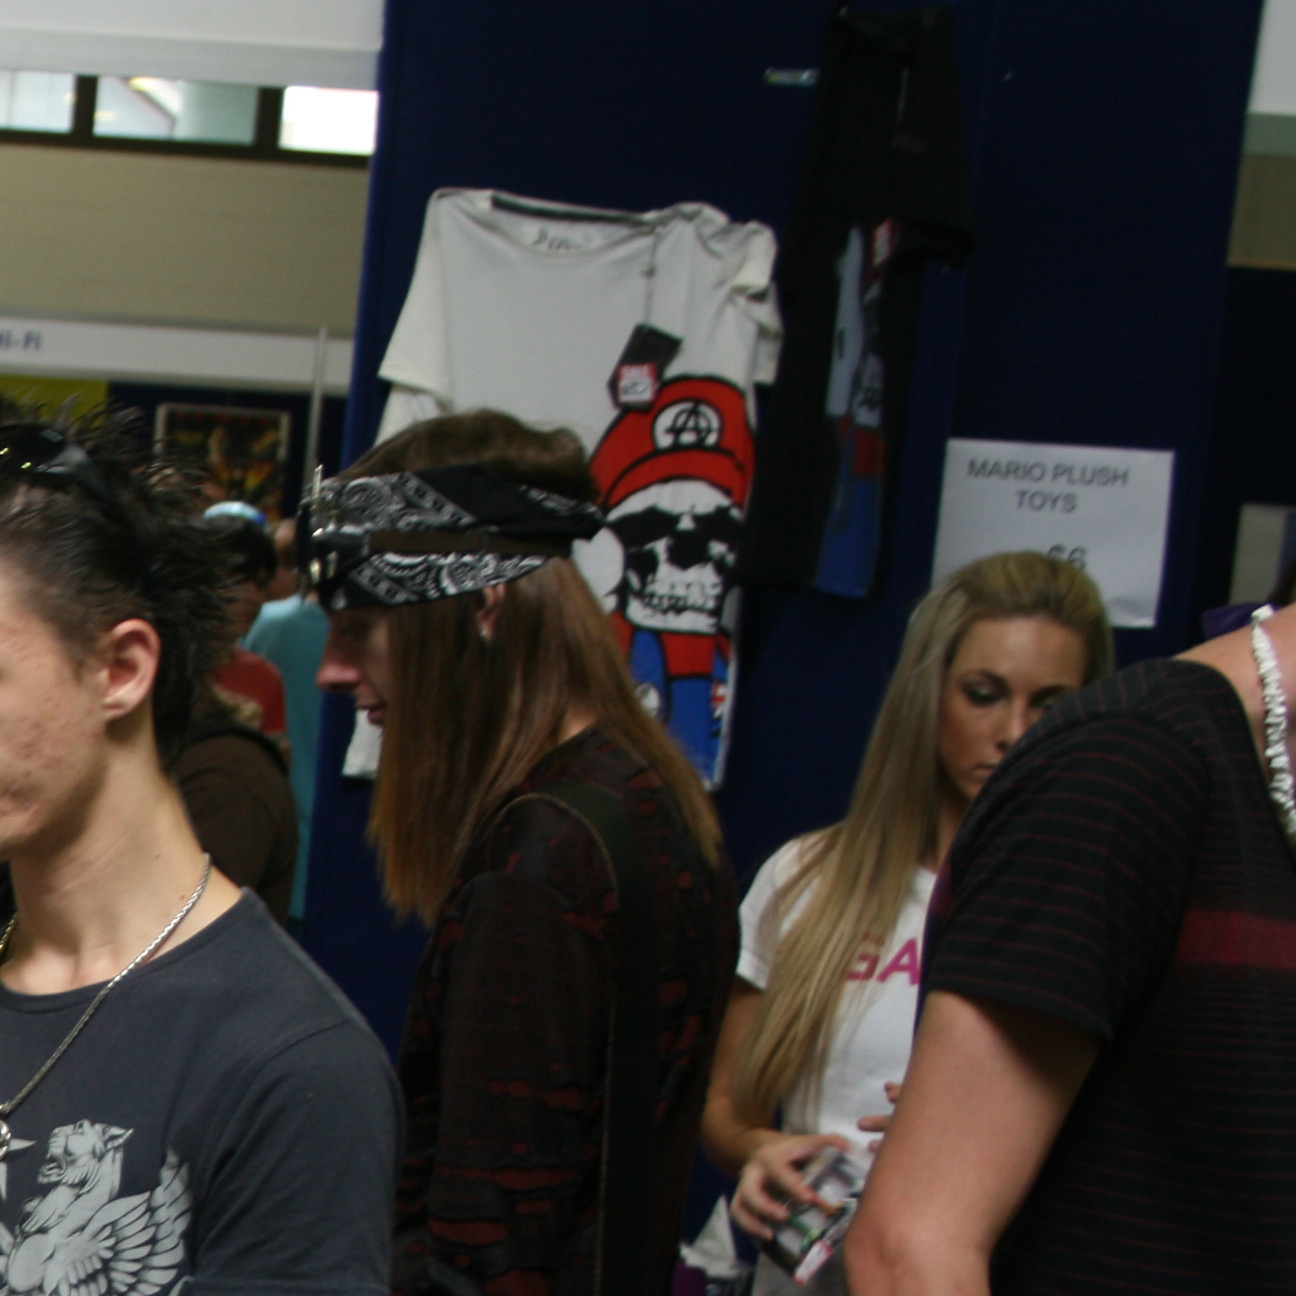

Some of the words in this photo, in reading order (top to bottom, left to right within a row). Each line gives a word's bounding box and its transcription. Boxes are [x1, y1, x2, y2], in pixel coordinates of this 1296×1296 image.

[967, 458, 1047, 482] MARIO
[1051, 464, 1131, 487] PLUSH
[1015, 489, 1079, 513] TOYS
